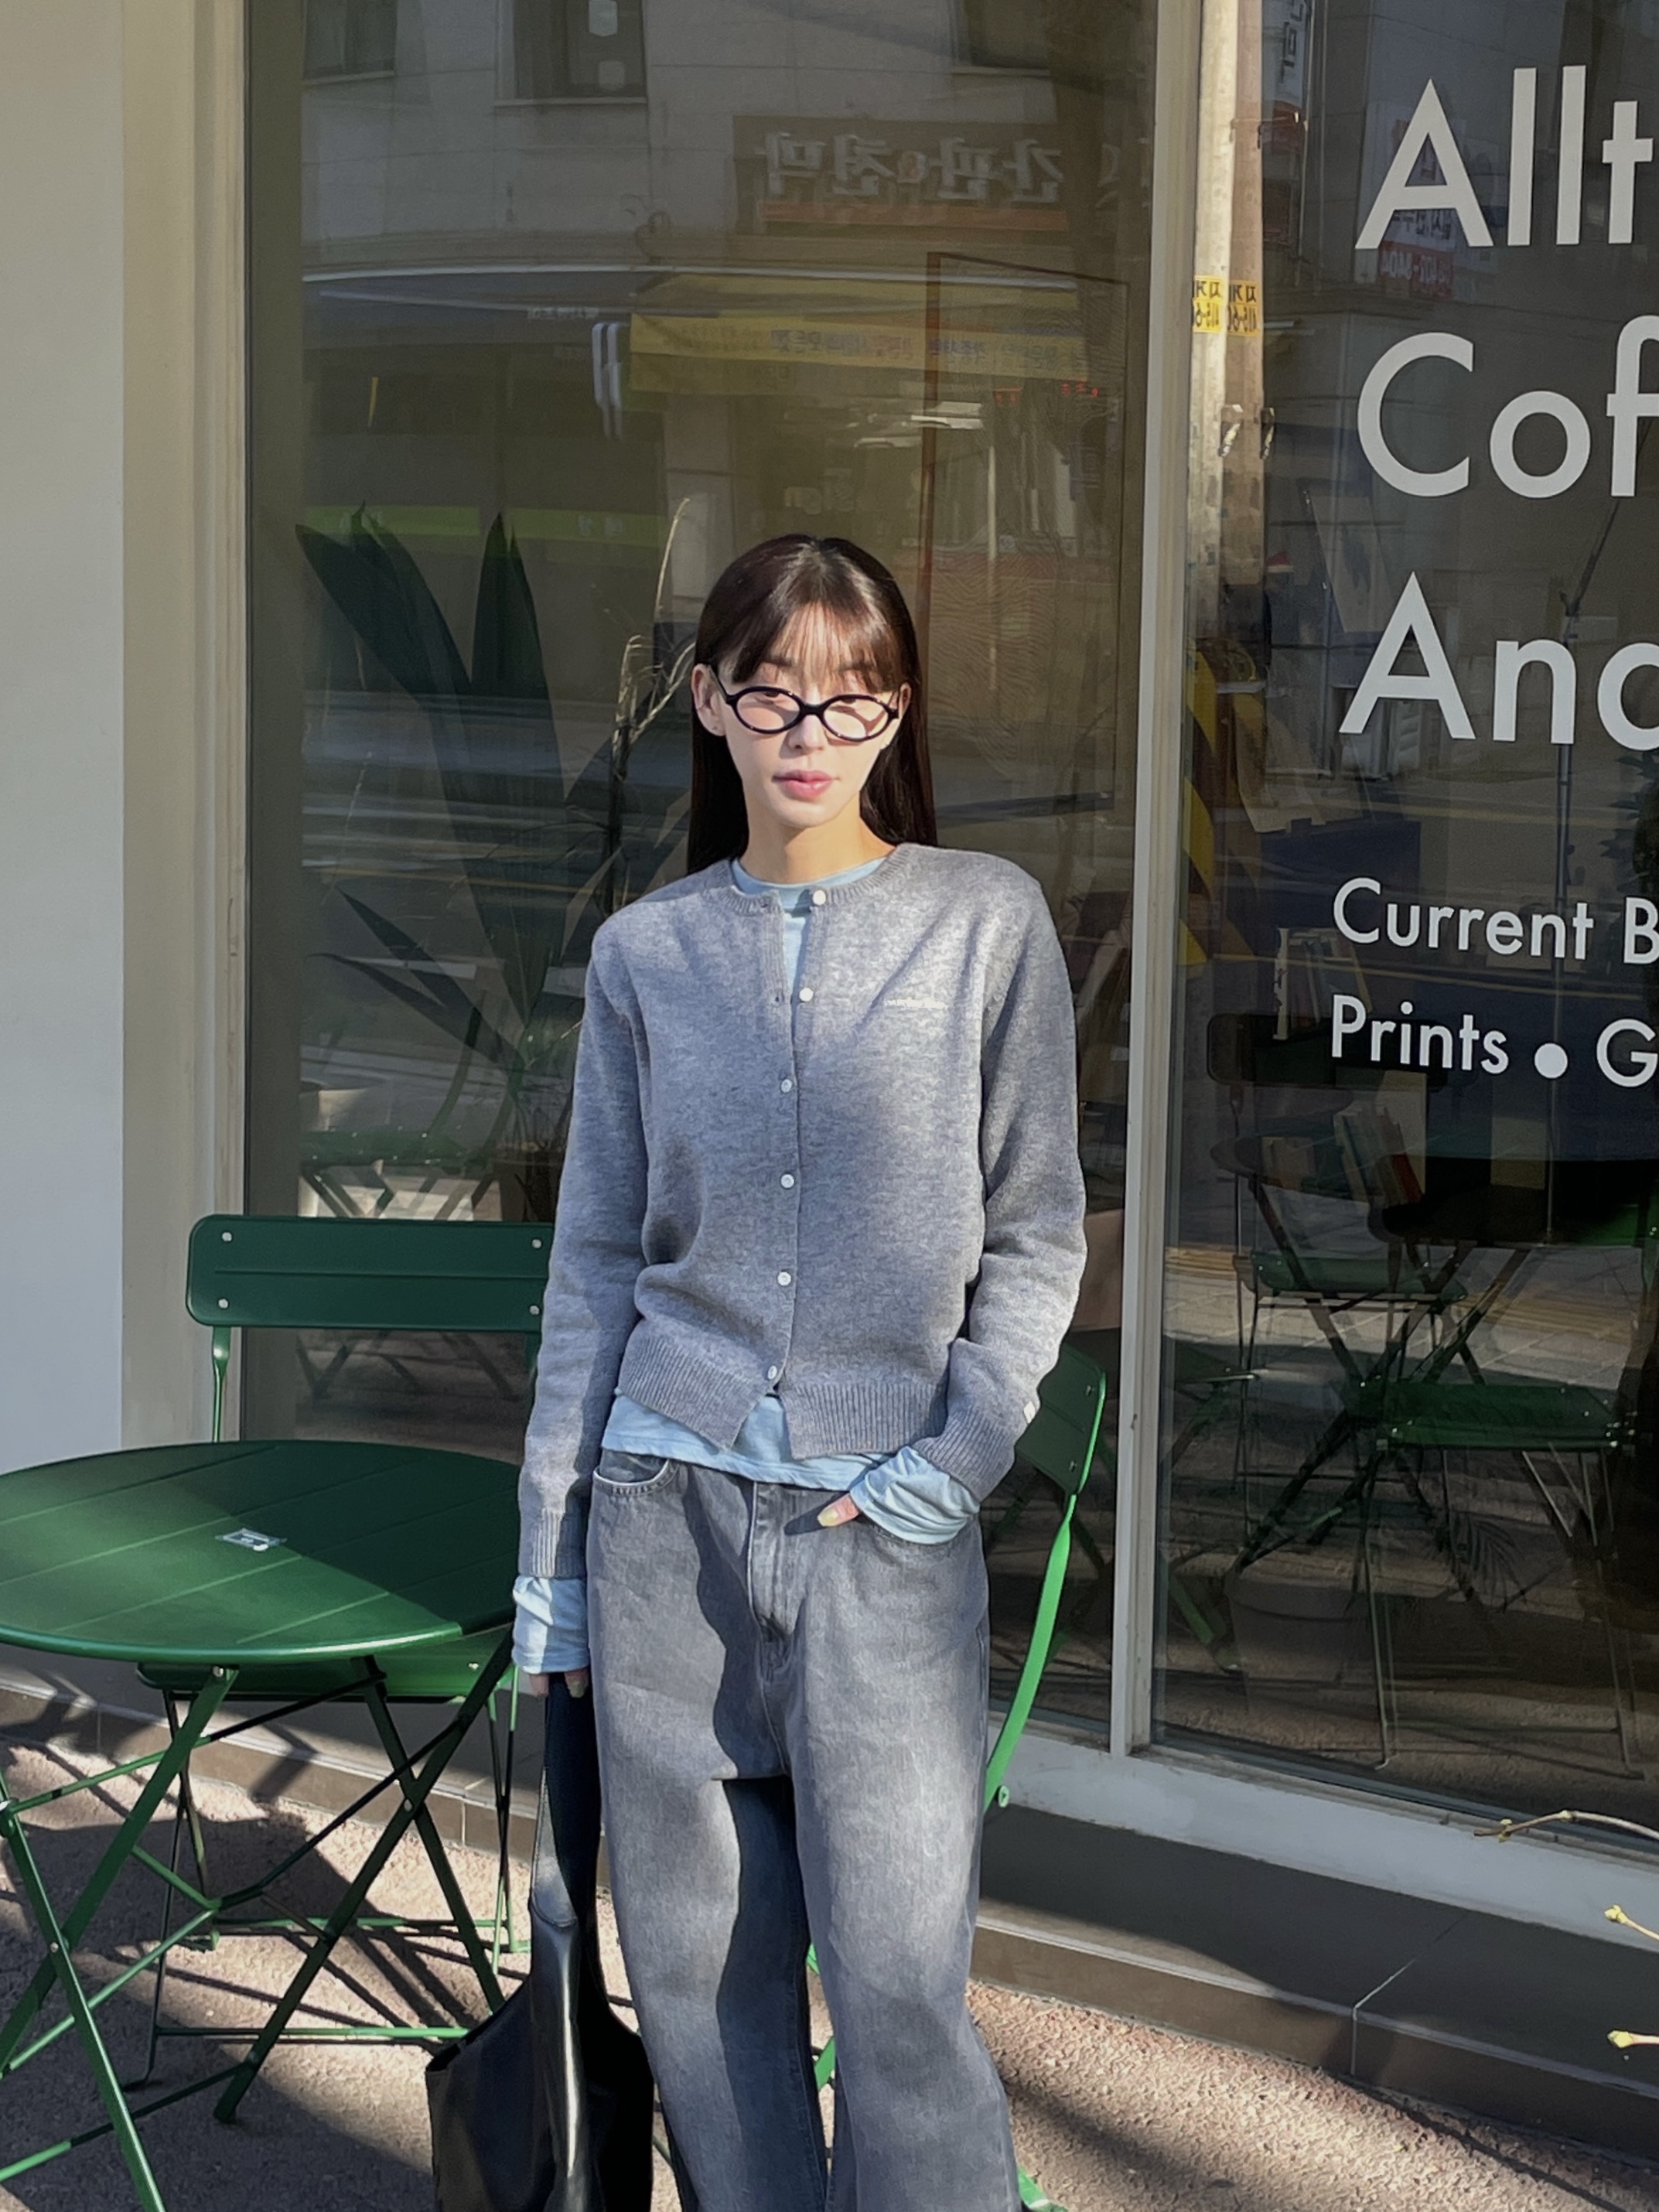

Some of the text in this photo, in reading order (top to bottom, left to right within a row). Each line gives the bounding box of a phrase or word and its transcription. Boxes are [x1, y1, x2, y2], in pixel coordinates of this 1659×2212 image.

[1354, 65, 1654, 249] Allt
[1357, 316, 1659, 497] Cof
[1333, 878, 1659, 964] Current B
[1332, 994, 1658, 1087] Prints G
